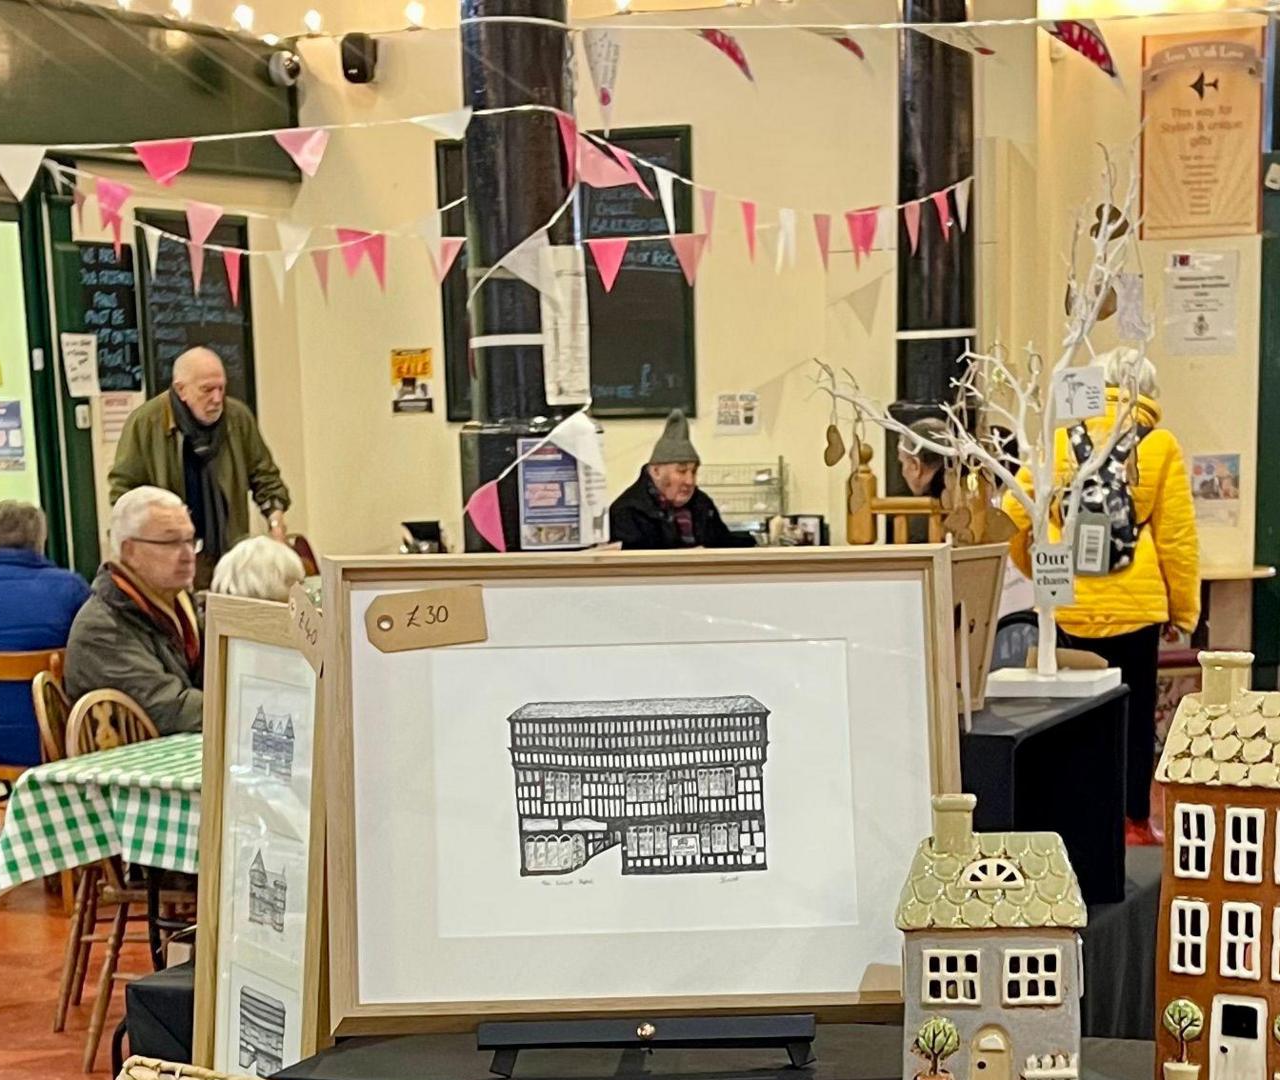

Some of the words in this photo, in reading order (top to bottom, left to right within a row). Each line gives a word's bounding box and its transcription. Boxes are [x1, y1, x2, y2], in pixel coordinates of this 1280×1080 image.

[1036, 552, 1069, 566] Our
[1036, 575, 1069, 586] chaos
[405, 604, 450, 628] £30
